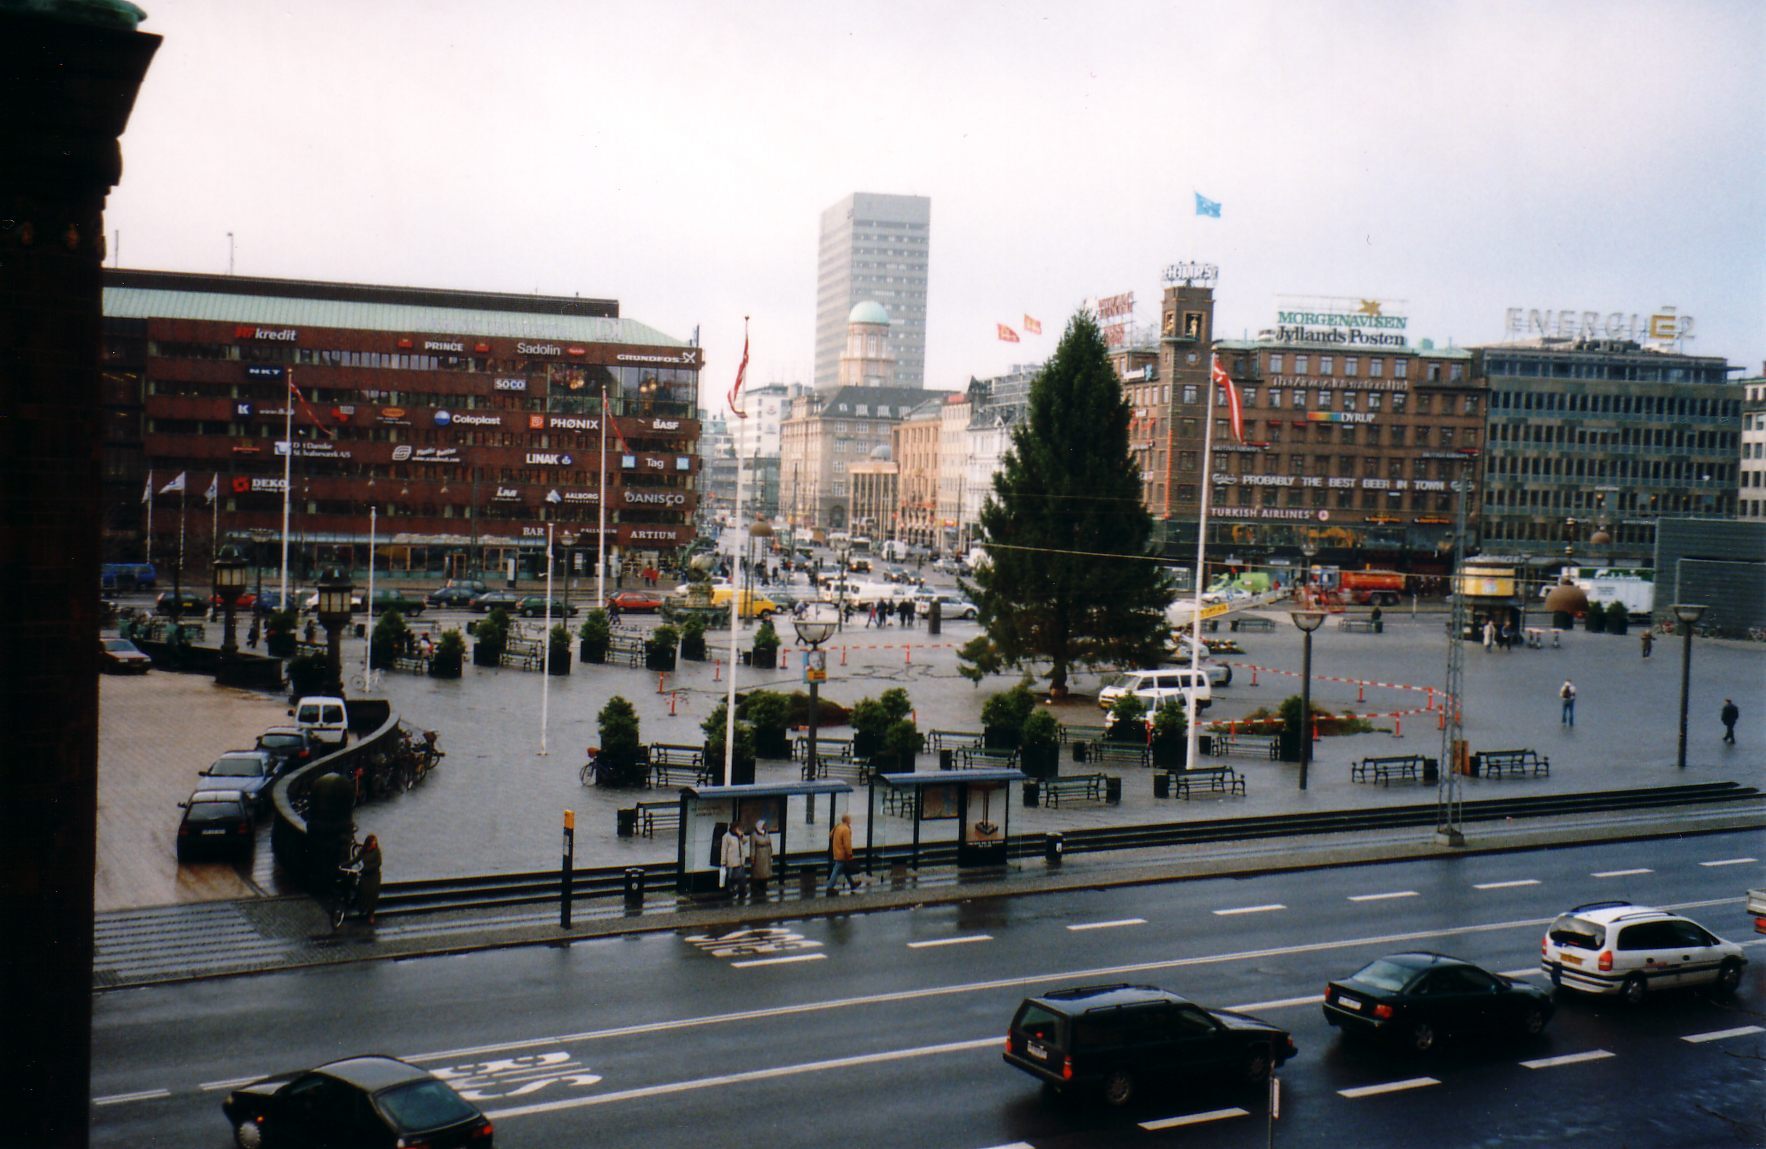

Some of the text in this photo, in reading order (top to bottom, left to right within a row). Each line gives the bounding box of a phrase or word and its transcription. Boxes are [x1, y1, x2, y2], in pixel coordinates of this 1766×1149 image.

[1277, 311, 1408, 329] MORGENAVISEN
[1276, 326, 1406, 346] Jyllands Posten
[424, 341, 465, 352] PRINCE
[516, 342, 562, 356] Sadolin
[616, 353, 681, 363] GRUNDFOS
[452, 414, 502, 426] Coloplast
[1340, 412, 1376, 423] DYRUP
[550, 418, 600, 430] PHØNIX
[652, 420, 680, 430] BASF
[525, 453, 560, 465] LINAK
[645, 457, 664, 470] Tag
[1242, 475, 1296, 486] PROBABLY
[1302, 476, 1323, 488] THE
[1328, 478, 1357, 489] BEST
[1362, 478, 1390, 489] BEER
[1396, 480, 1408, 490] IN
[1413, 480, 1445, 491] TOWN
[564, 492, 599, 500] AALBORG
[625, 493, 685, 505] DANISCO
[1211, 507, 1310, 519] TURKISH AIRLINES
[522, 526, 545, 536] BAR
[630, 530, 677, 539] ARTIUM
